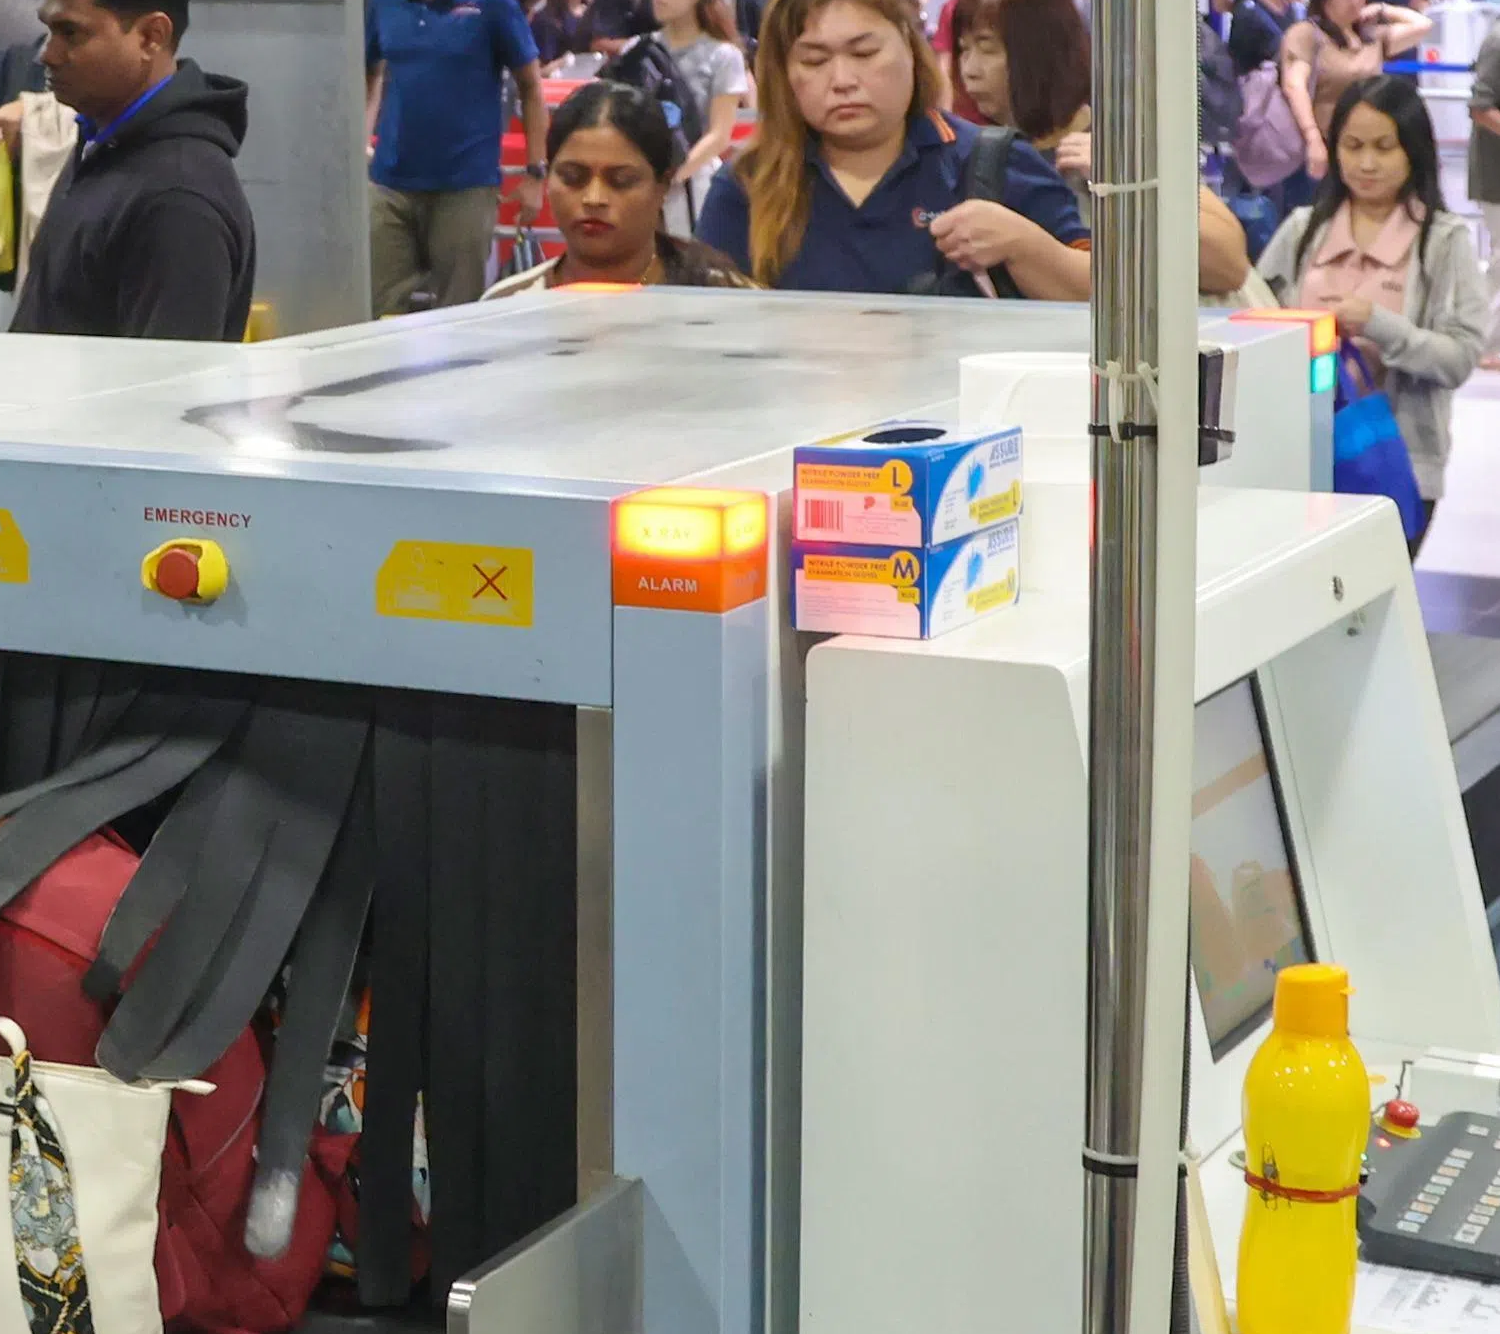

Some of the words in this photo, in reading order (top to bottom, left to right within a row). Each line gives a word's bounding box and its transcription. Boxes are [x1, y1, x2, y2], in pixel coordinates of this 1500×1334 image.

[892, 466, 902, 488] L
[143, 506, 252, 529] EMERGENCY
[892, 557, 915, 580] M
[638, 575, 698, 593] ALARM
